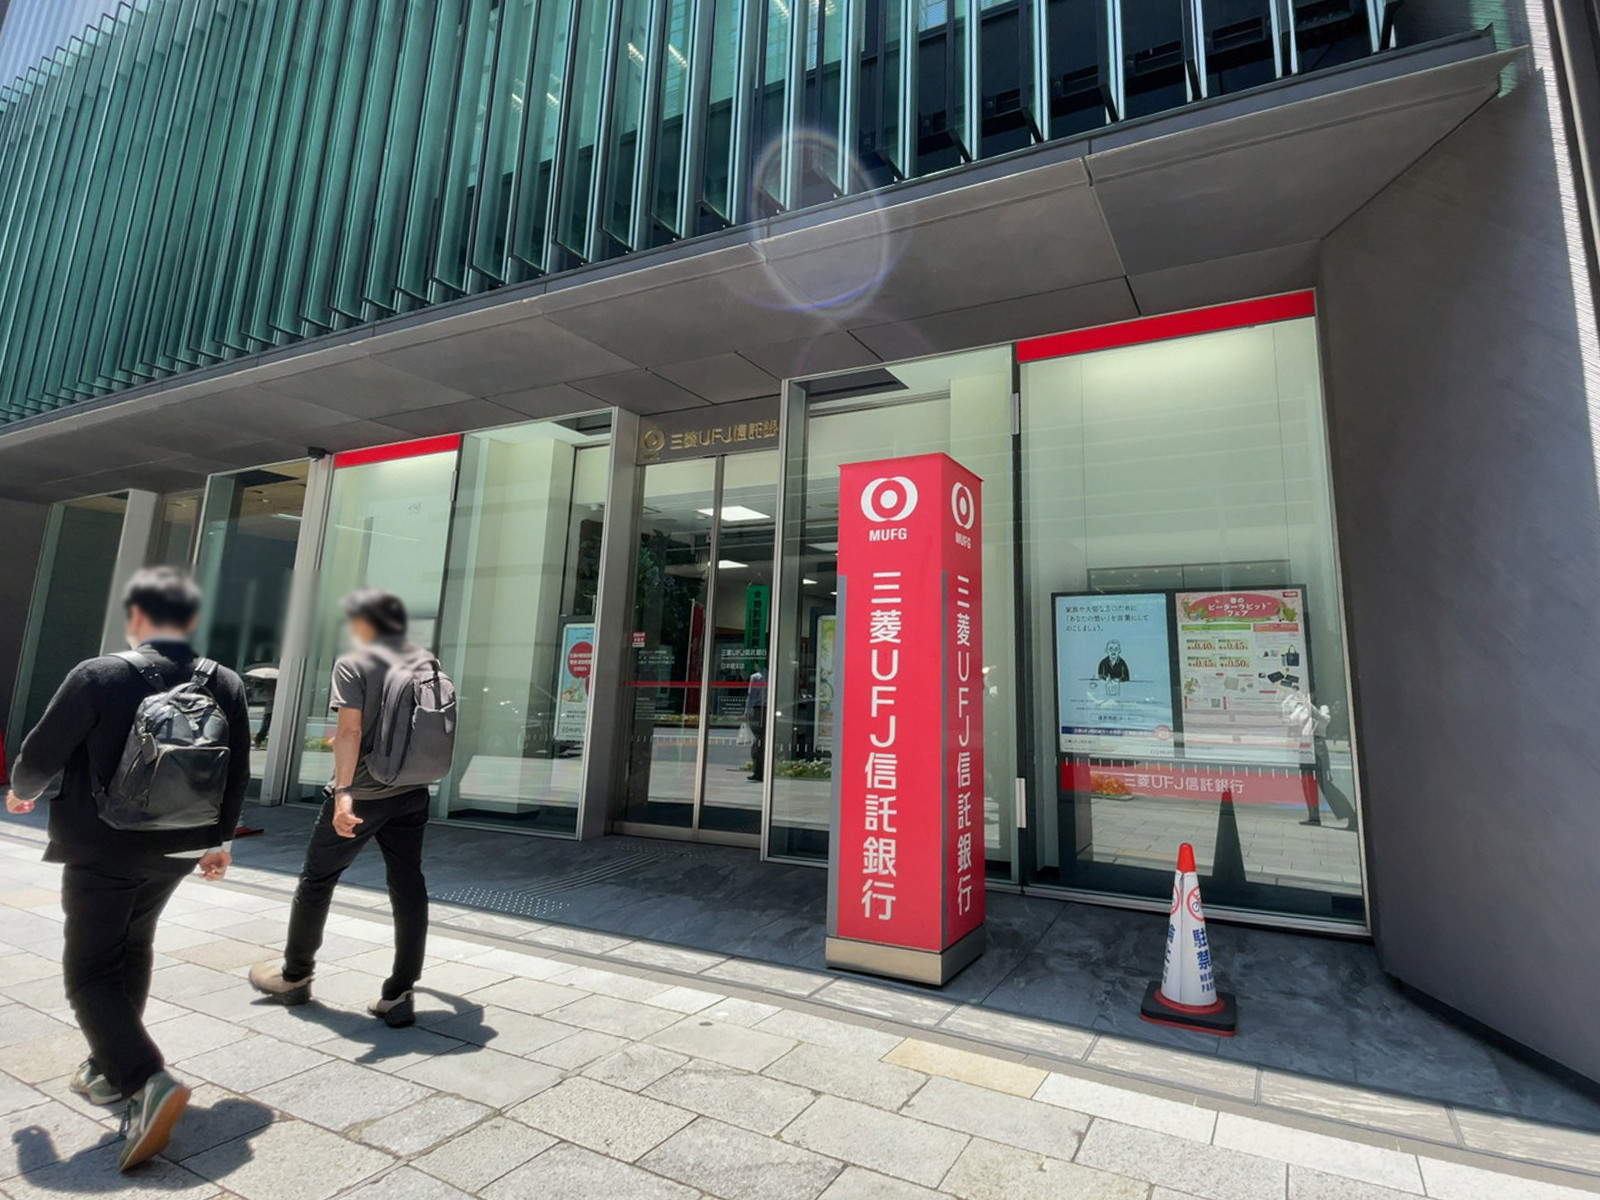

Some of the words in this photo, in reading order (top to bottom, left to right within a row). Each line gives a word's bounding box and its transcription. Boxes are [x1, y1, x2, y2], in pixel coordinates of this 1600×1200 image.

[868, 528, 908, 542] MUFG
[955, 532, 972, 550] MUFG
[862, 571, 902, 920] 三菱UFJ信託銀行
[956, 575, 972, 916] 三菱UFJ信託銀行
[1123, 773, 1245, 794] 三菱UFJ信託銀行
